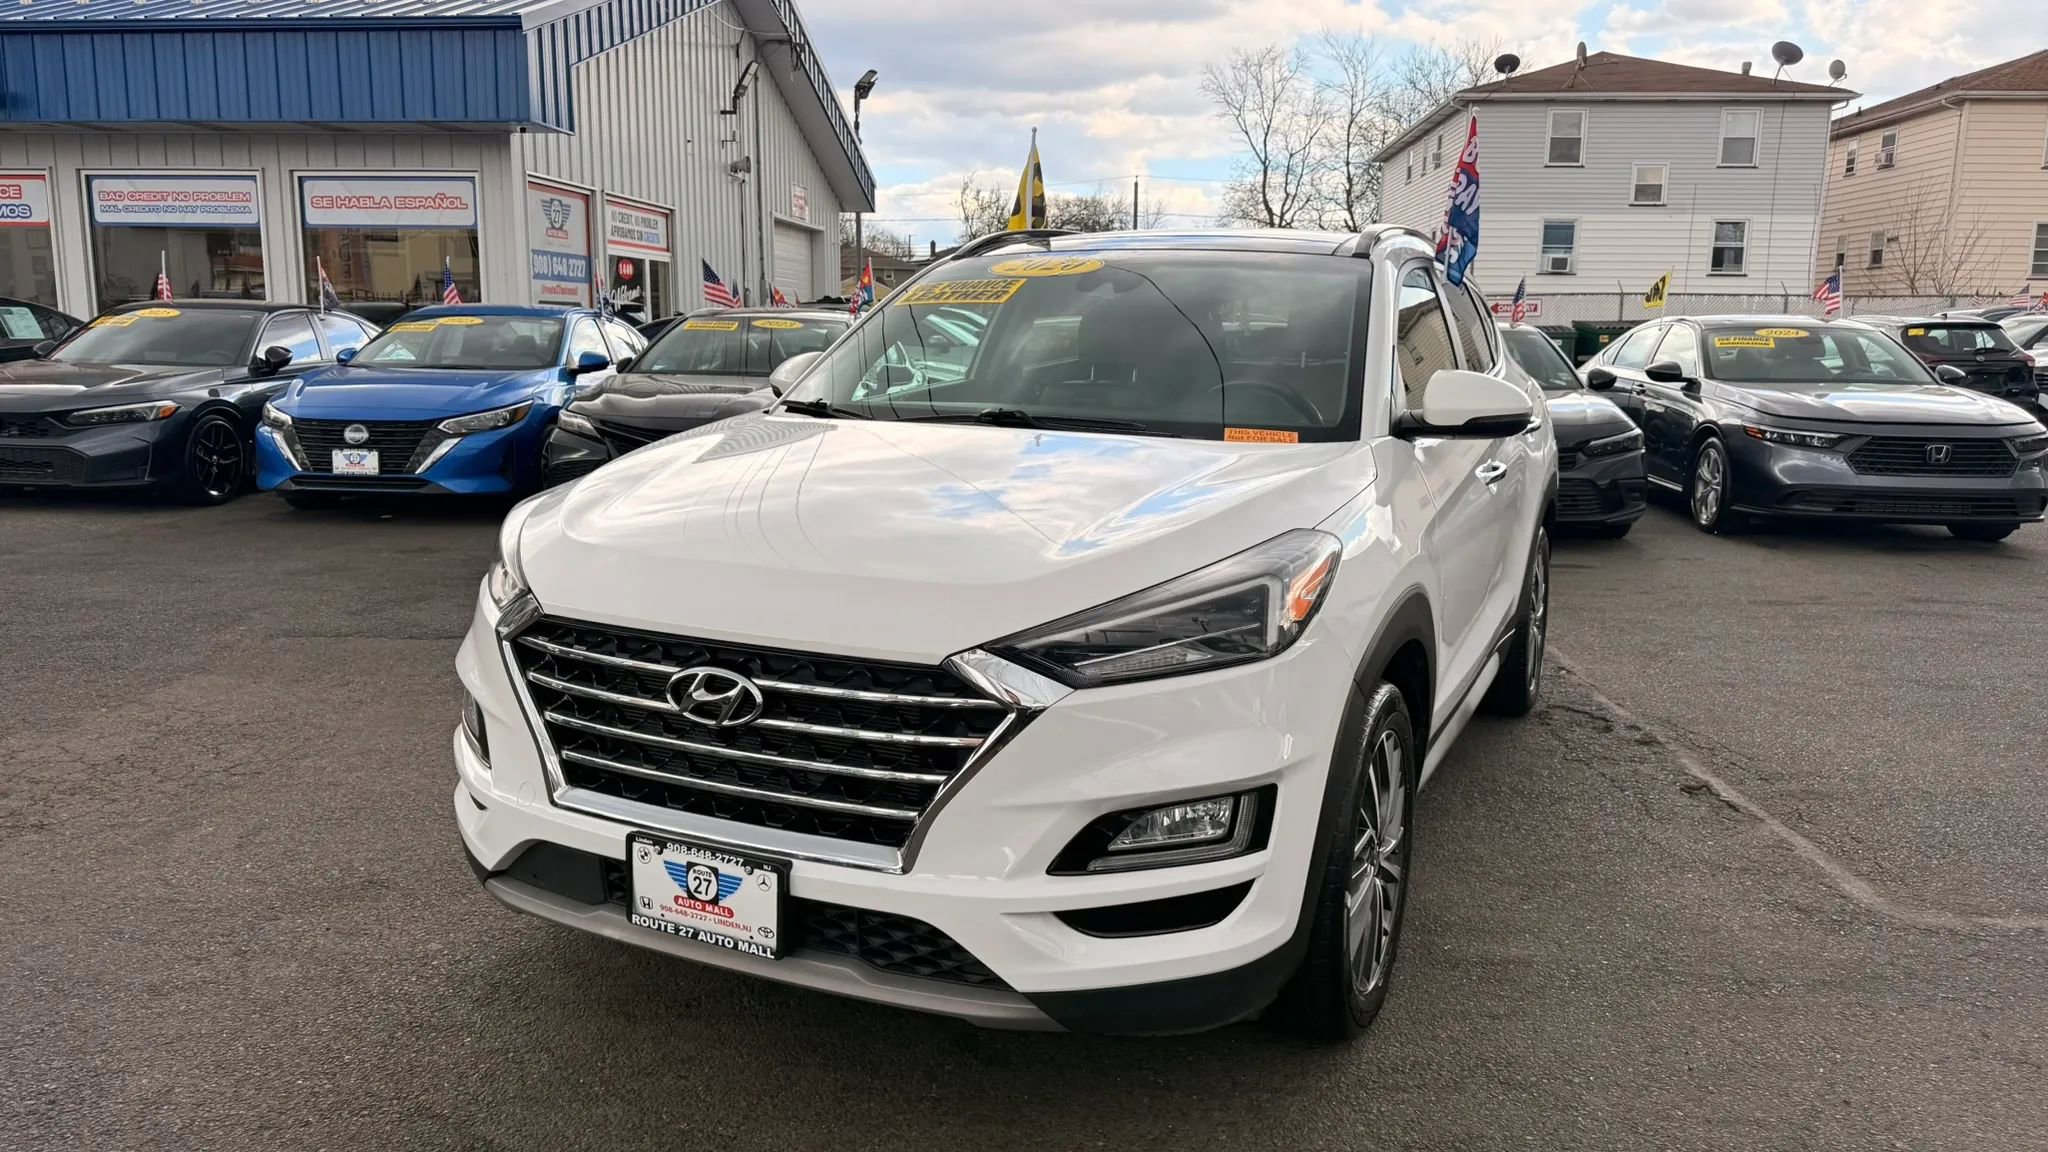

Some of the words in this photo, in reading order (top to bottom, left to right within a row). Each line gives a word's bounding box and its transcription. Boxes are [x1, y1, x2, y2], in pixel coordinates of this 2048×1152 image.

[99, 191, 125, 202] BAD
[127, 192, 171, 202] CREDIT
[172, 192, 191, 202] NO
[193, 192, 251, 203] PROBLEM
[311, 195, 333, 208] SE
[336, 196, 393, 209] HABLA
[395, 192, 469, 209] ESPAÑOL
[100, 205, 122, 213] MAL
[122, 205, 162, 214] CREDITO
[162, 206, 177, 214] NO
[179, 206, 199, 214] HAY
[200, 206, 252, 215] PROBLEMA
[552, 209, 561, 224] 27
[553, 256, 567, 276] 648
[568, 258, 586, 278] 2727
[943, 279, 1019, 291] FINANCE
[903, 289, 1009, 301] LEATHER
[1252, 429, 1295, 437] VEHICLE
[665, 841, 745, 867] 908-648-2727
[692, 868, 712, 879] ROUTE
[693, 876, 712, 896] 27
[659, 903, 707, 922] 908-648-2727
[677, 896, 704, 911] AUTO
[705, 903, 731, 918] MALL
[631, 913, 675, 934] ROUTE
[678, 925, 694, 938] 27
[697, 931, 734, 948] AUTO
[737, 940, 775, 959] MALL
